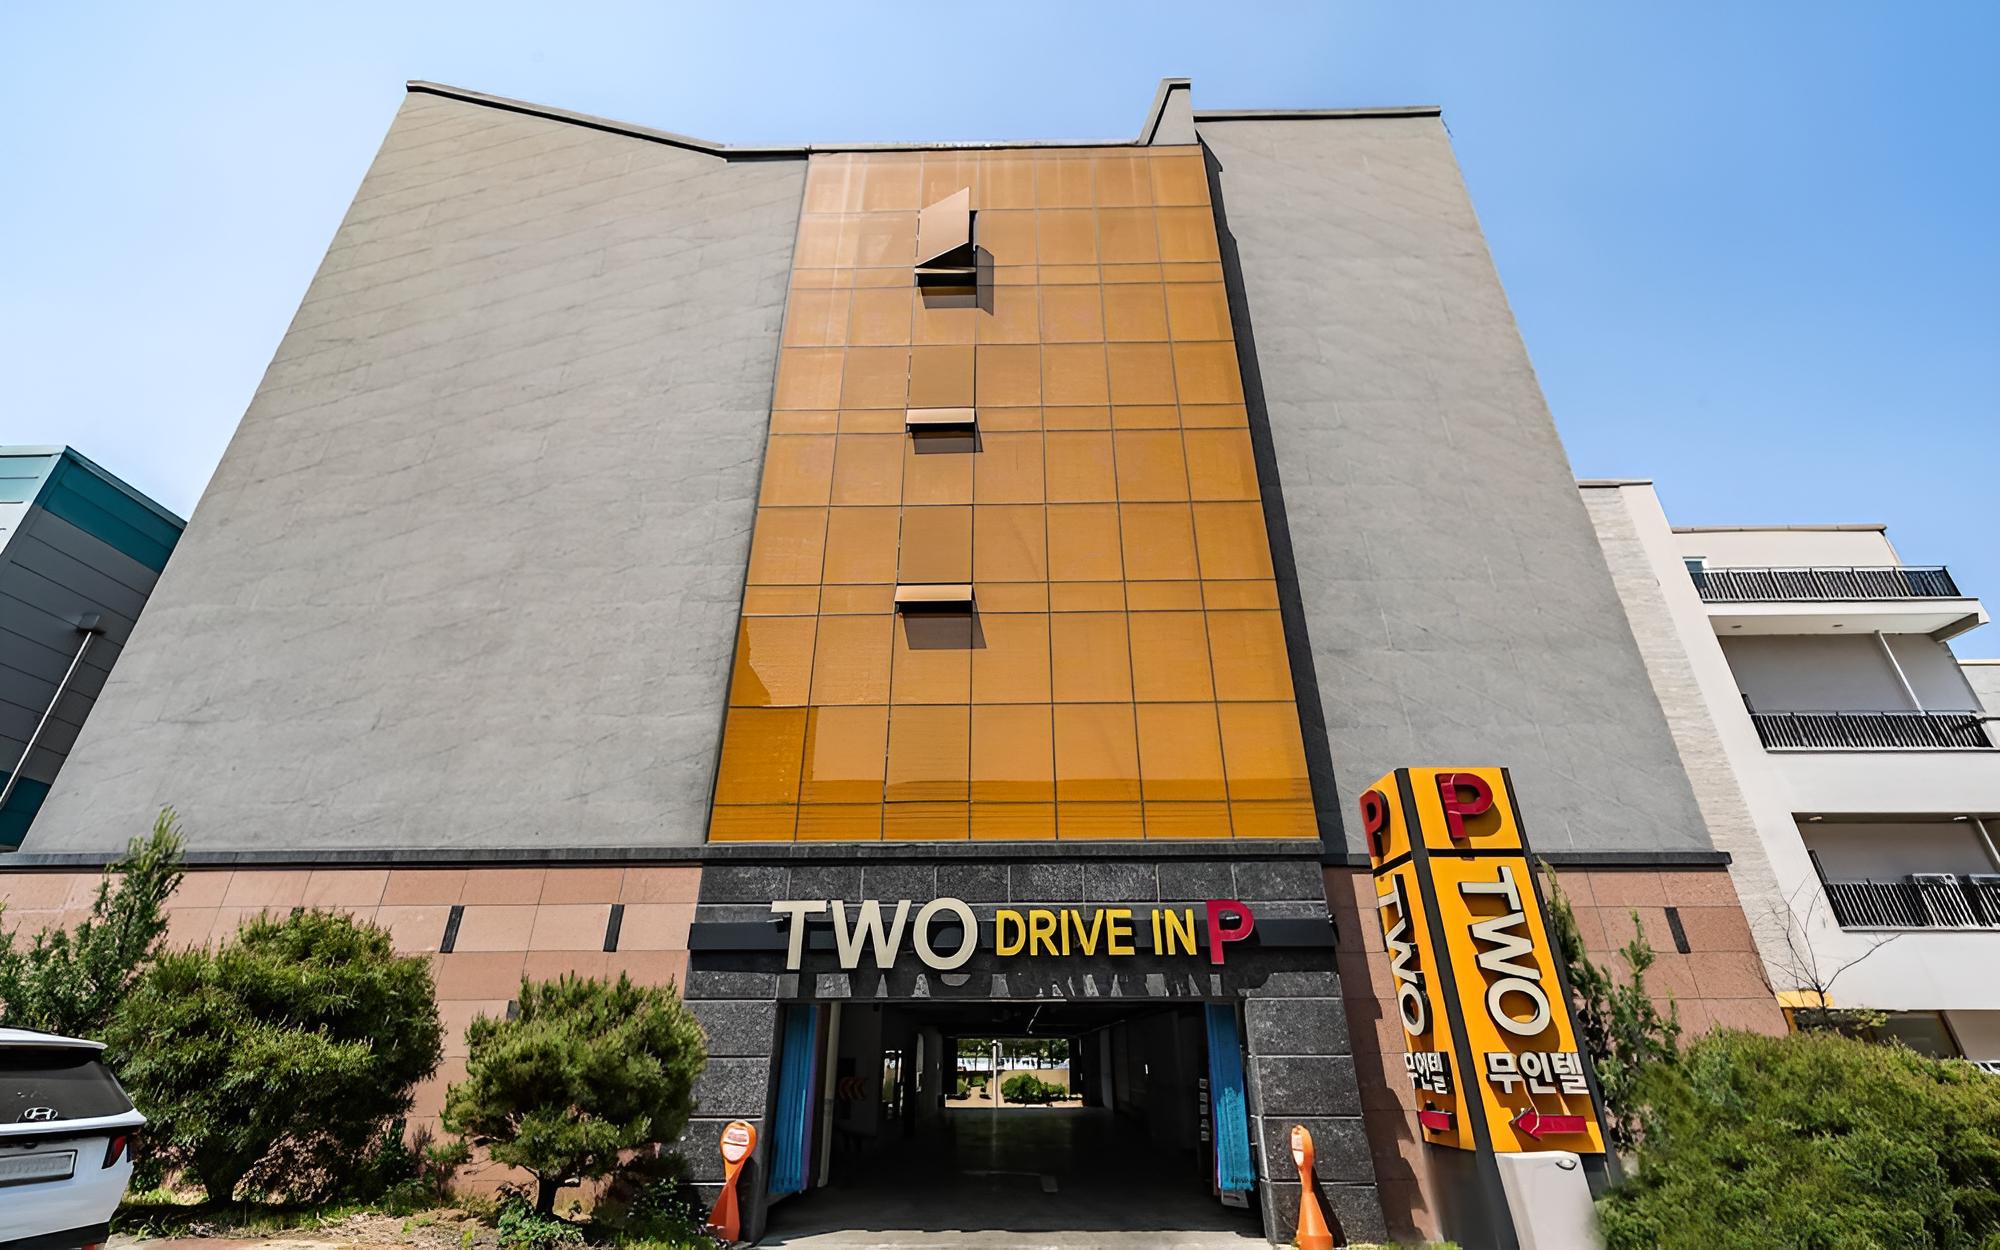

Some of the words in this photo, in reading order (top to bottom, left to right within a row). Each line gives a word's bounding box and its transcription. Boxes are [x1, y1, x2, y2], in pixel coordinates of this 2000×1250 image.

[1360, 788, 1388, 858] P
[1436, 773, 1493, 839] P
[771, 897, 978, 969] TWO
[996, 909, 1136, 956] DRIVE
[1152, 908, 1198, 956] IN
[1207, 899, 1255, 966] P
[1377, 874, 1425, 1036] TWO
[1461, 866, 1551, 1036] TWO
[1403, 1052, 1448, 1095] 무인텔
[1489, 1052, 1590, 1095] 무인텔
